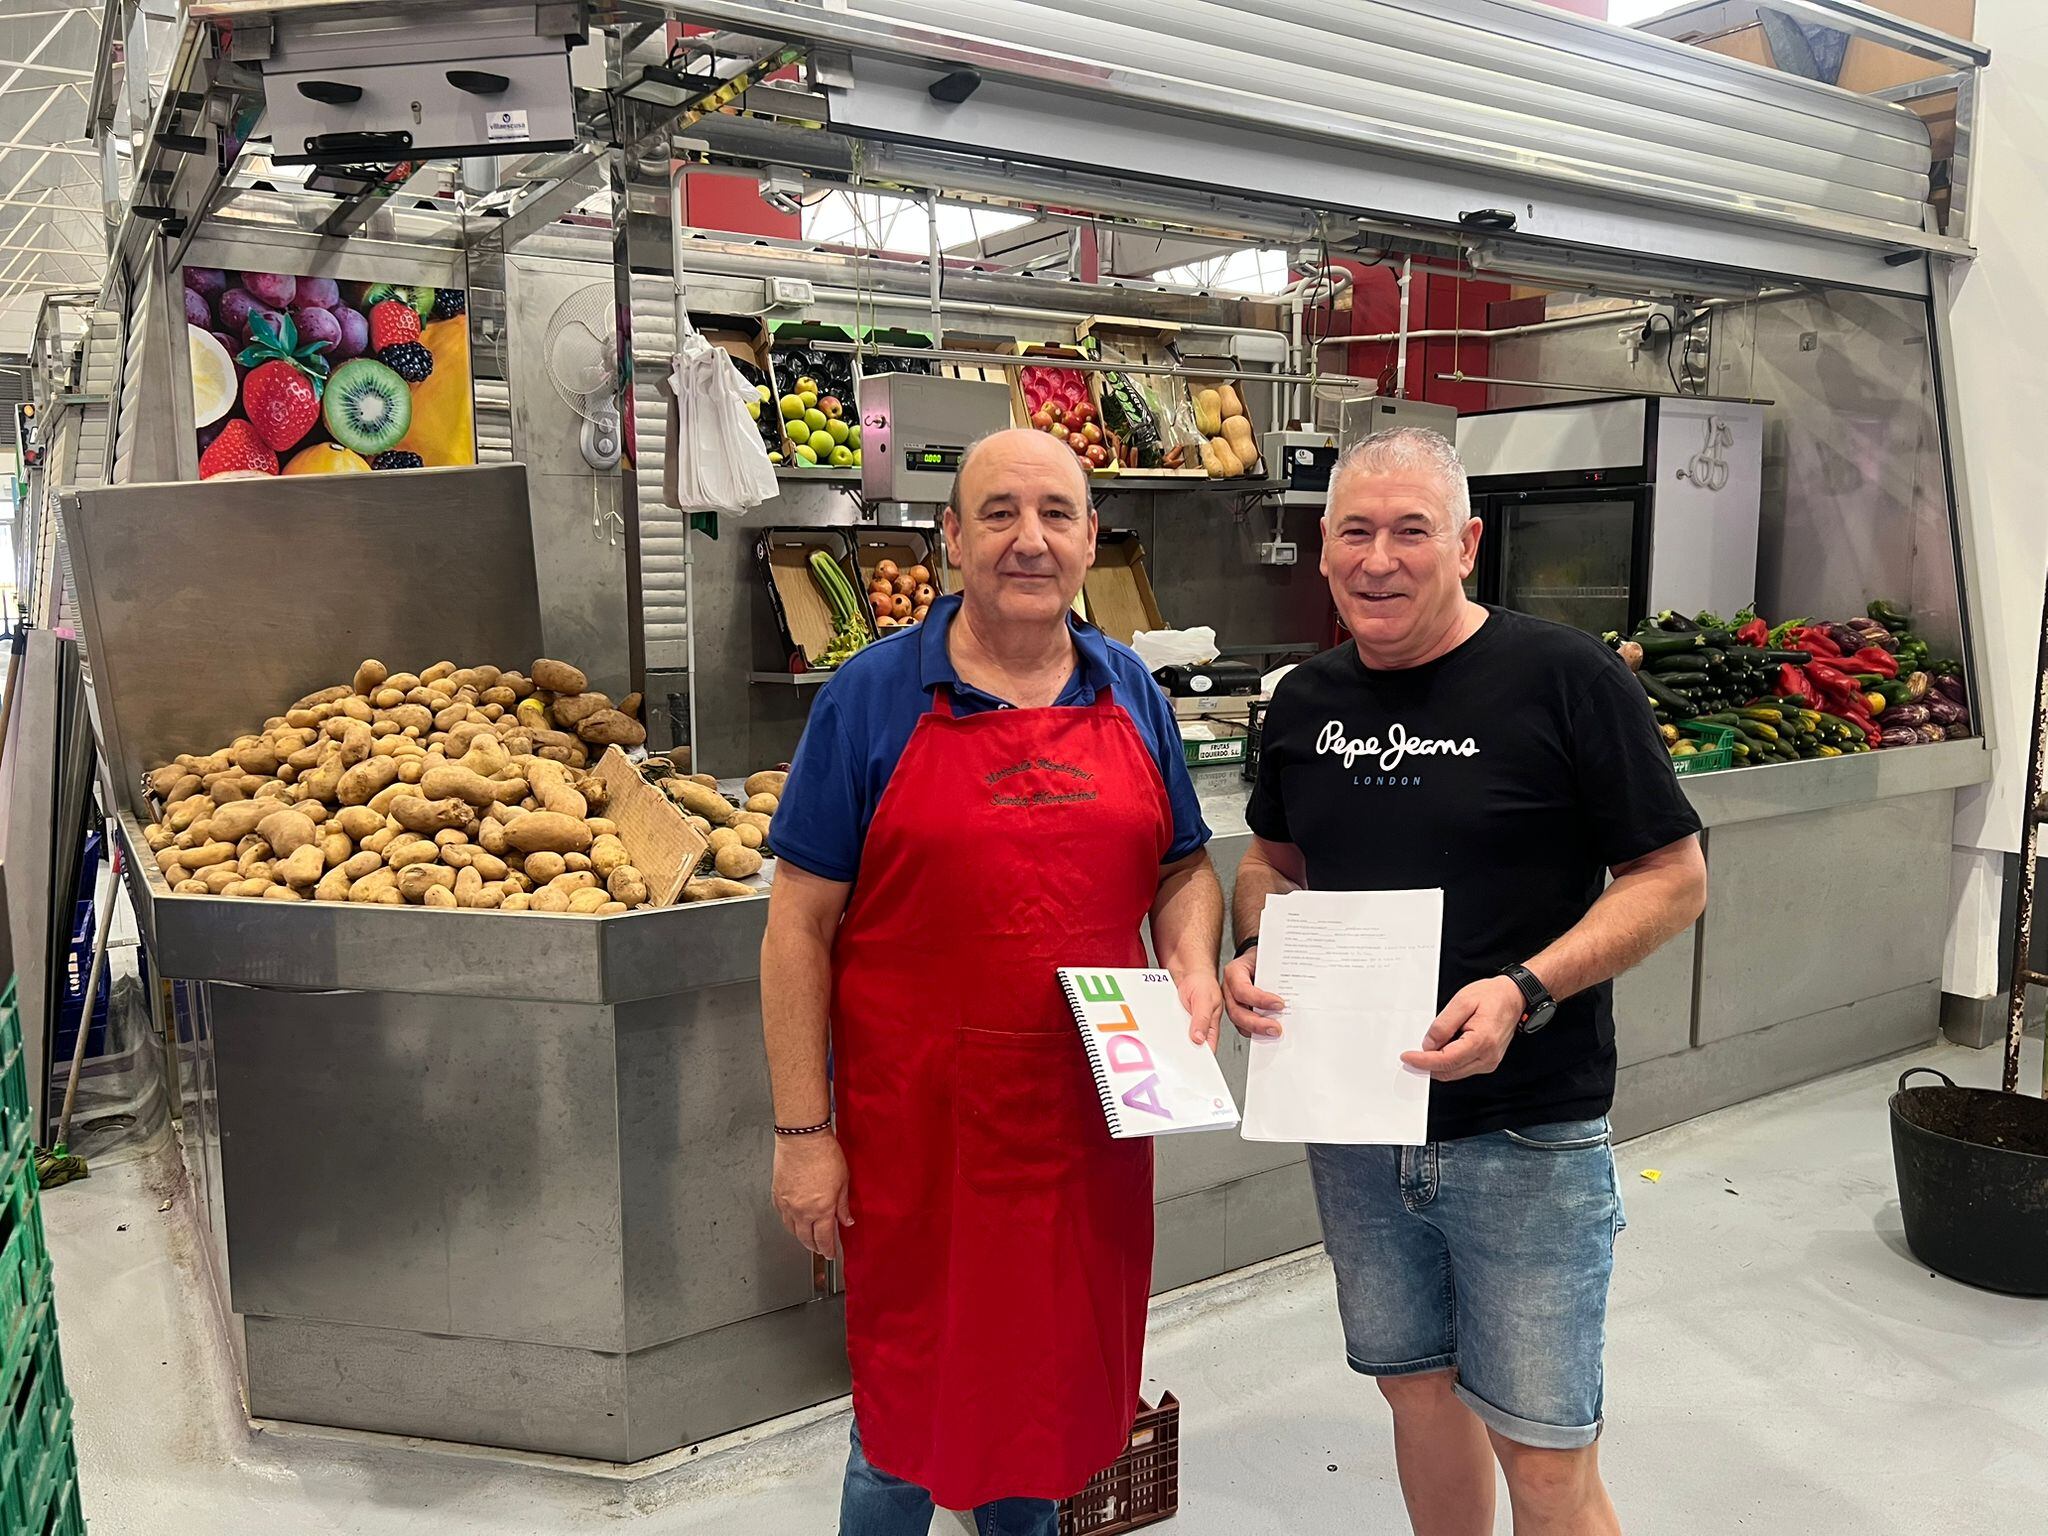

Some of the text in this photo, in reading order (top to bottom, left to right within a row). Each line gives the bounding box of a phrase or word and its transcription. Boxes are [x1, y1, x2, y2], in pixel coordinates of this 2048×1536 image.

[1210, 743, 1230, 751] FRUTAS
[1316, 720, 1481, 771] Pepe Jeans
[1353, 776, 1422, 786] LONDON
[1142, 973, 1169, 983] 2024
[1074, 974, 1175, 1121] ADLE
